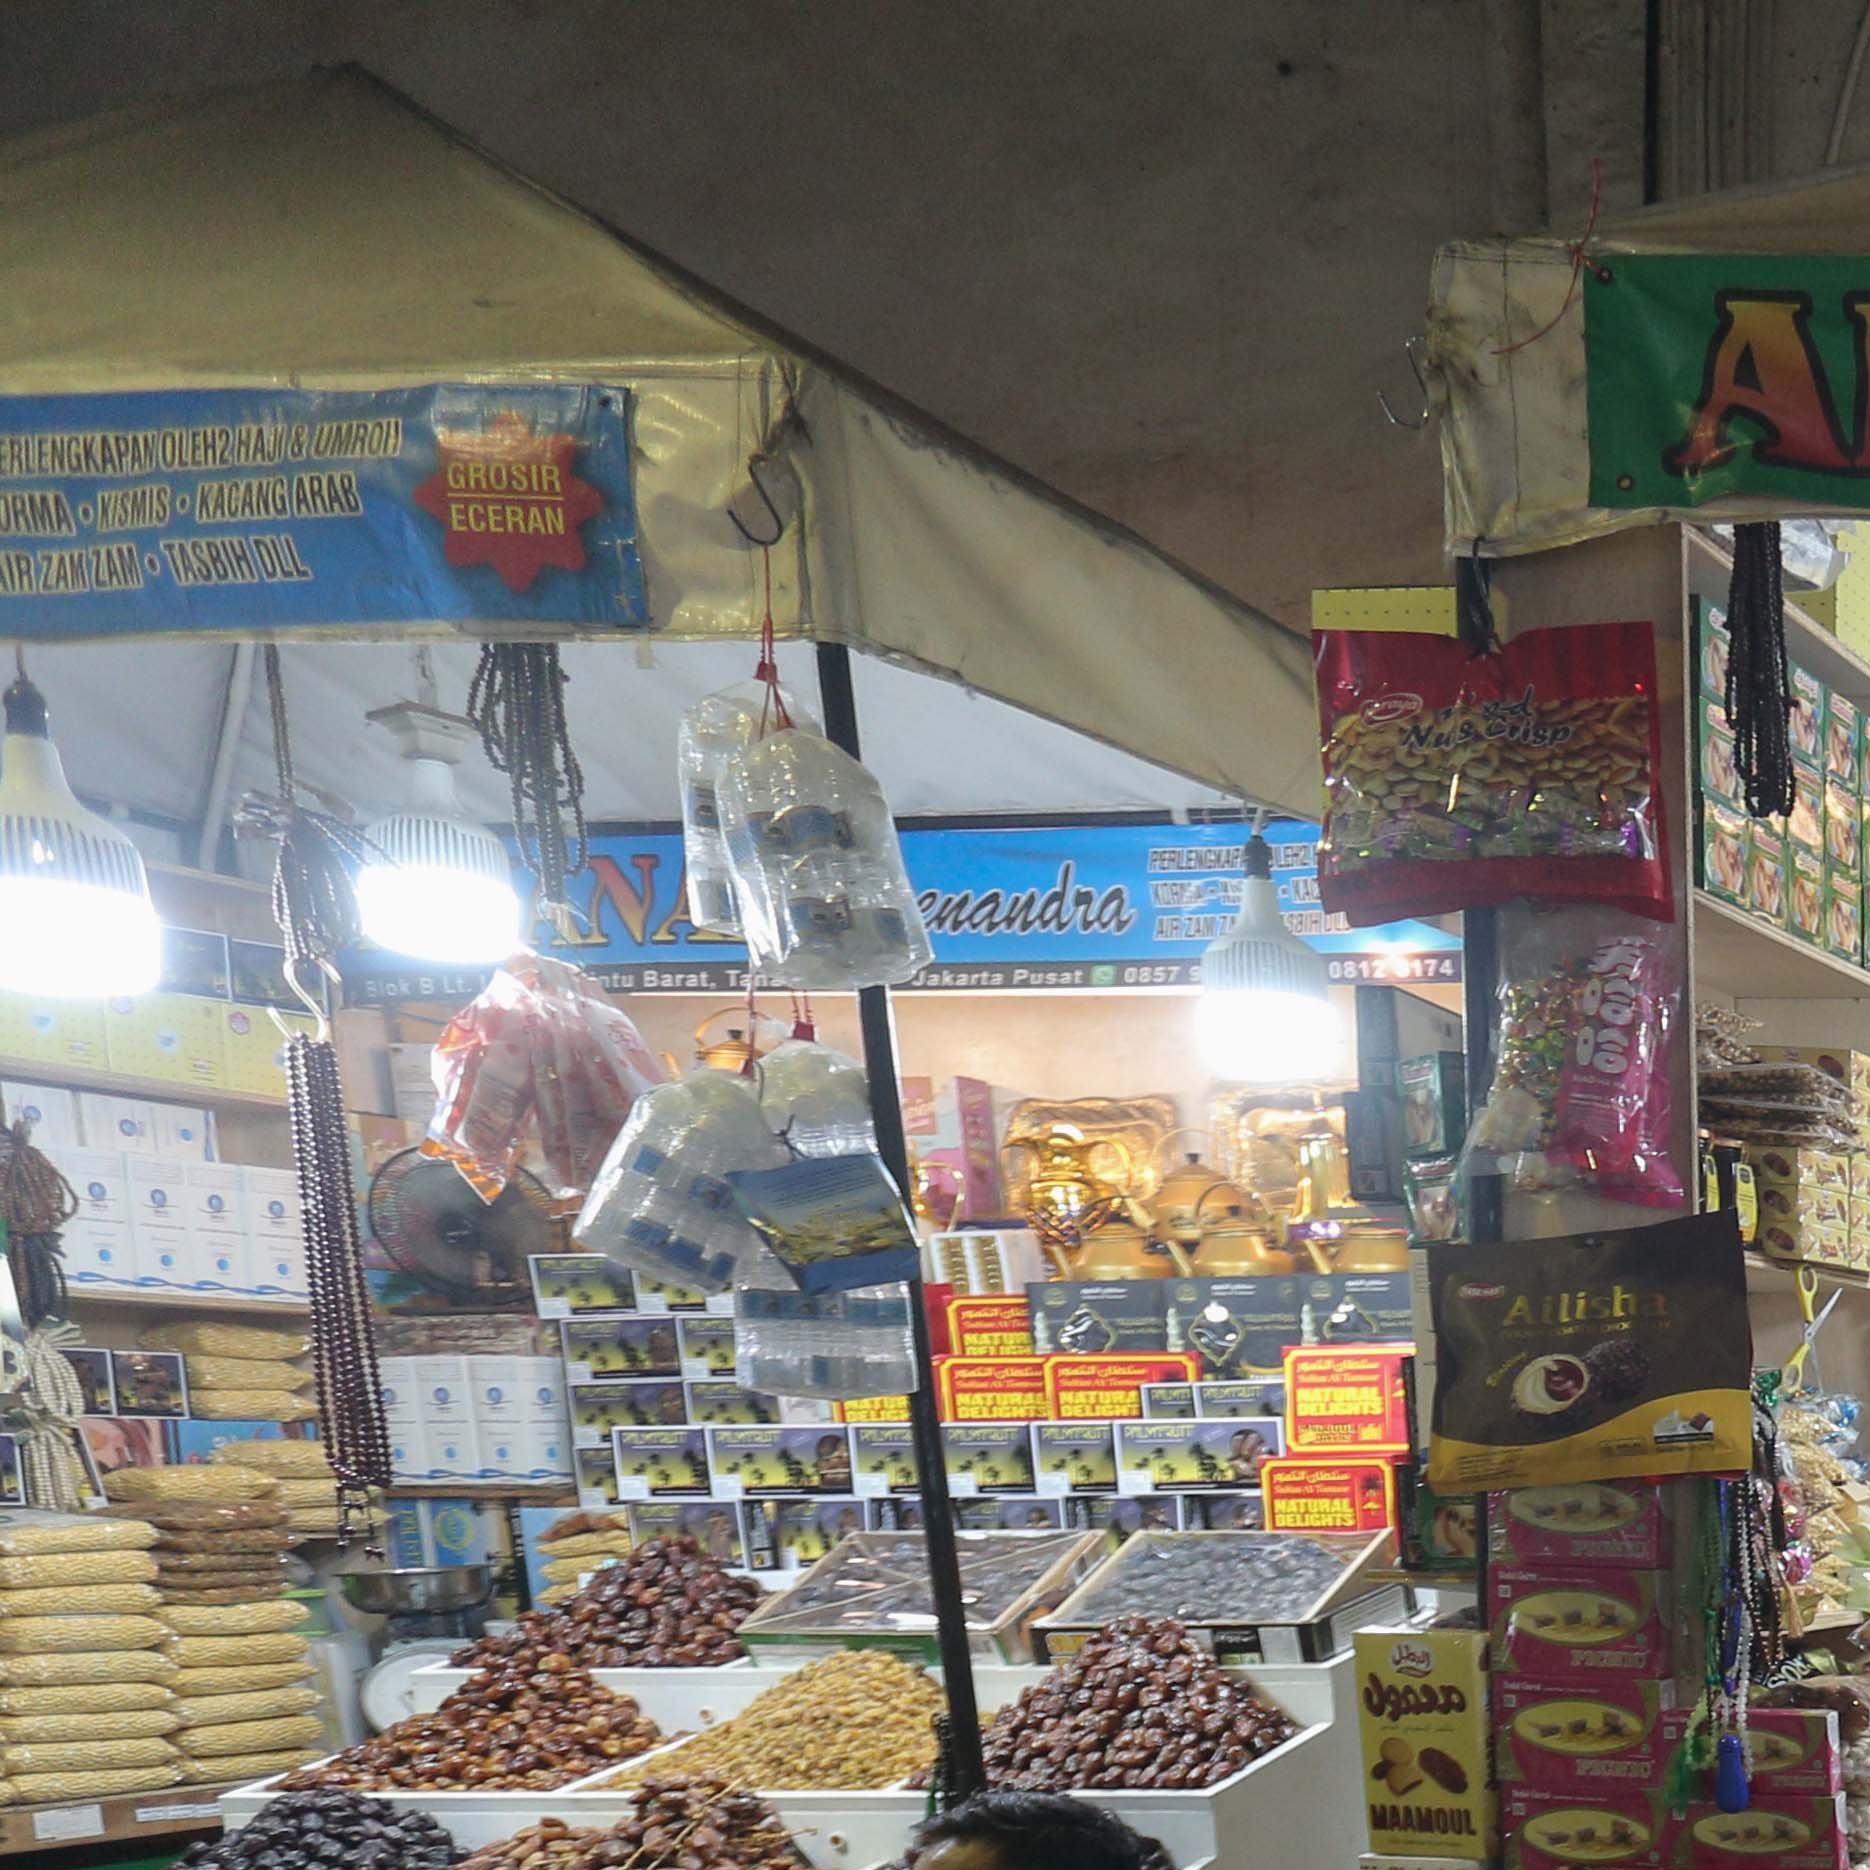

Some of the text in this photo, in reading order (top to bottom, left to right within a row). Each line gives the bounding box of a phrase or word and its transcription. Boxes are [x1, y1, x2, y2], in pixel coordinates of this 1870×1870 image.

[160, 425, 232, 470] OLEH2
[233, 422, 286, 465] HAJI
[289, 425, 306, 460] &
[311, 418, 402, 458] UMROH
[447, 462, 562, 493] GROSIR
[97, 484, 170, 532] KISMIS
[196, 476, 291, 523] KACANG
[294, 471, 363, 518] ARAB
[451, 503, 566, 536] ECERAN
[37, 549, 88, 594] ZAM
[91, 543, 145, 590] ZAM
[160, 537, 251, 587] TASBIH
[252, 535, 313, 582] DLL
[1399, 718, 1476, 750] Nus
[920, 858, 1136, 936] enandra
[911, 967, 1004, 989] Jakarta
[1012, 965, 1084, 987] Pusat
[1123, 965, 1179, 986] 0857
[1328, 958, 1386, 980] 0812
[1392, 957, 1455, 979] 174
[1058, 1390, 1141, 1405] NATURA
[1060, 1404, 1141, 1418] DELIGHT
[1369, 1803, 1478, 1837] MAAMOUL
